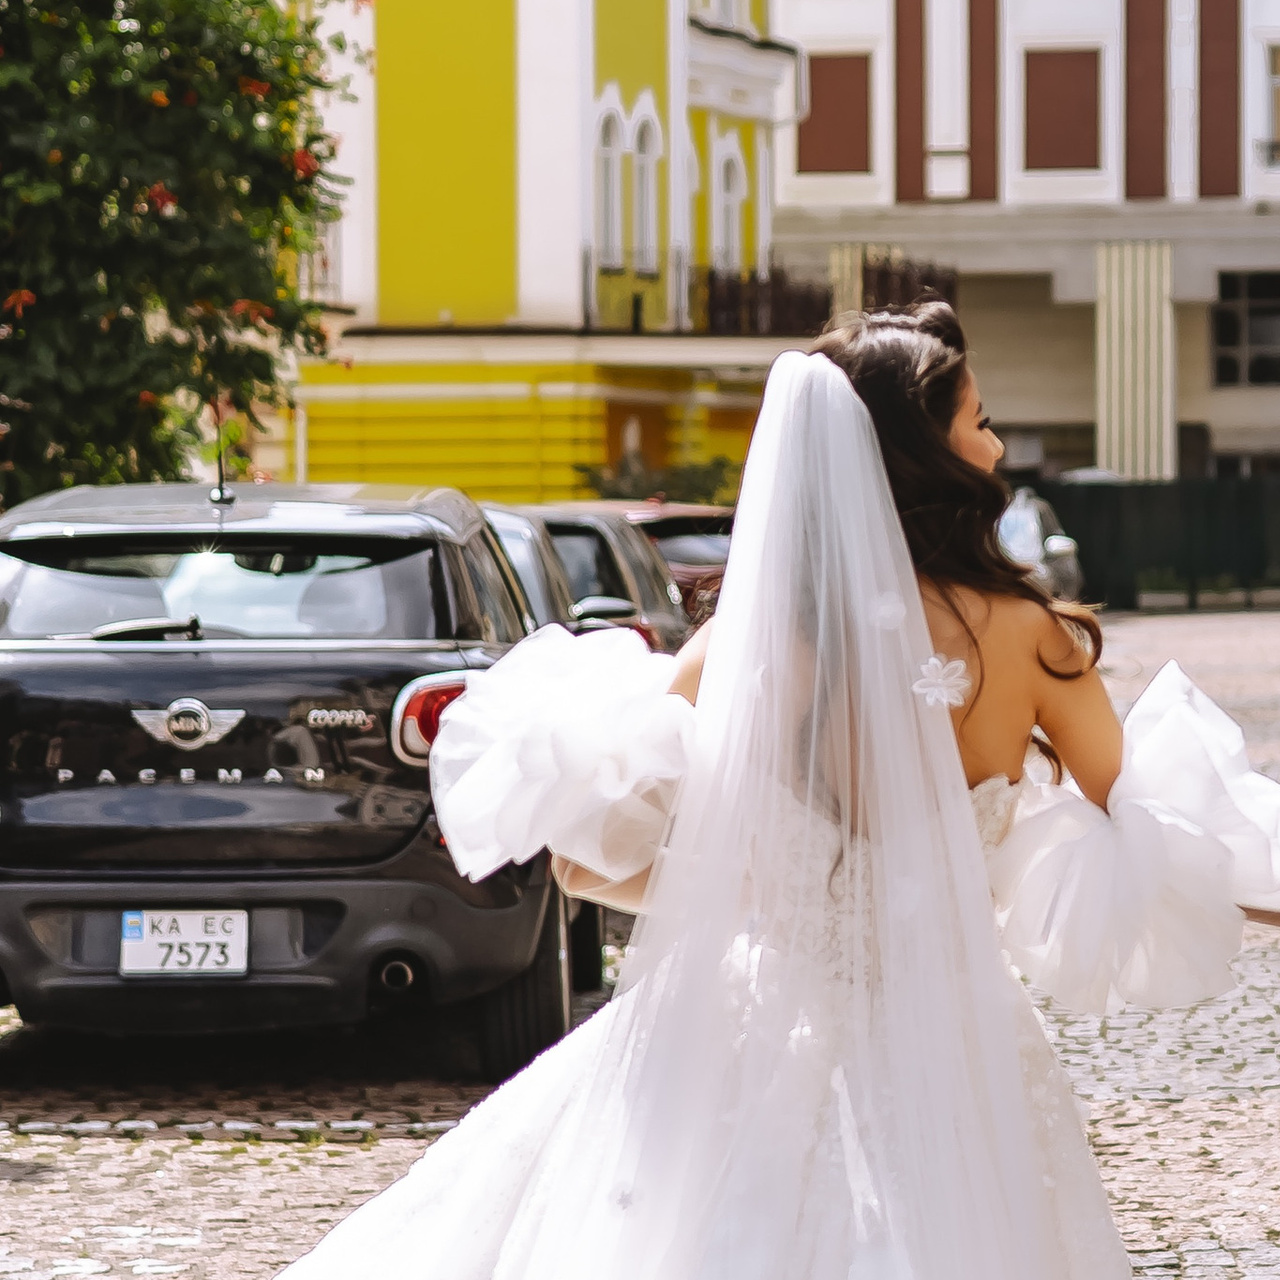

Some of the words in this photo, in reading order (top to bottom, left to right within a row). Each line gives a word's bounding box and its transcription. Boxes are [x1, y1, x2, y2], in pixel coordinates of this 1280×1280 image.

[170, 716, 206, 731] MINI
[58, 768, 325, 784] PACEMAN
[150, 917, 181, 935] KA
[204, 917, 234, 934] EC
[158, 942, 229, 967] 7573
